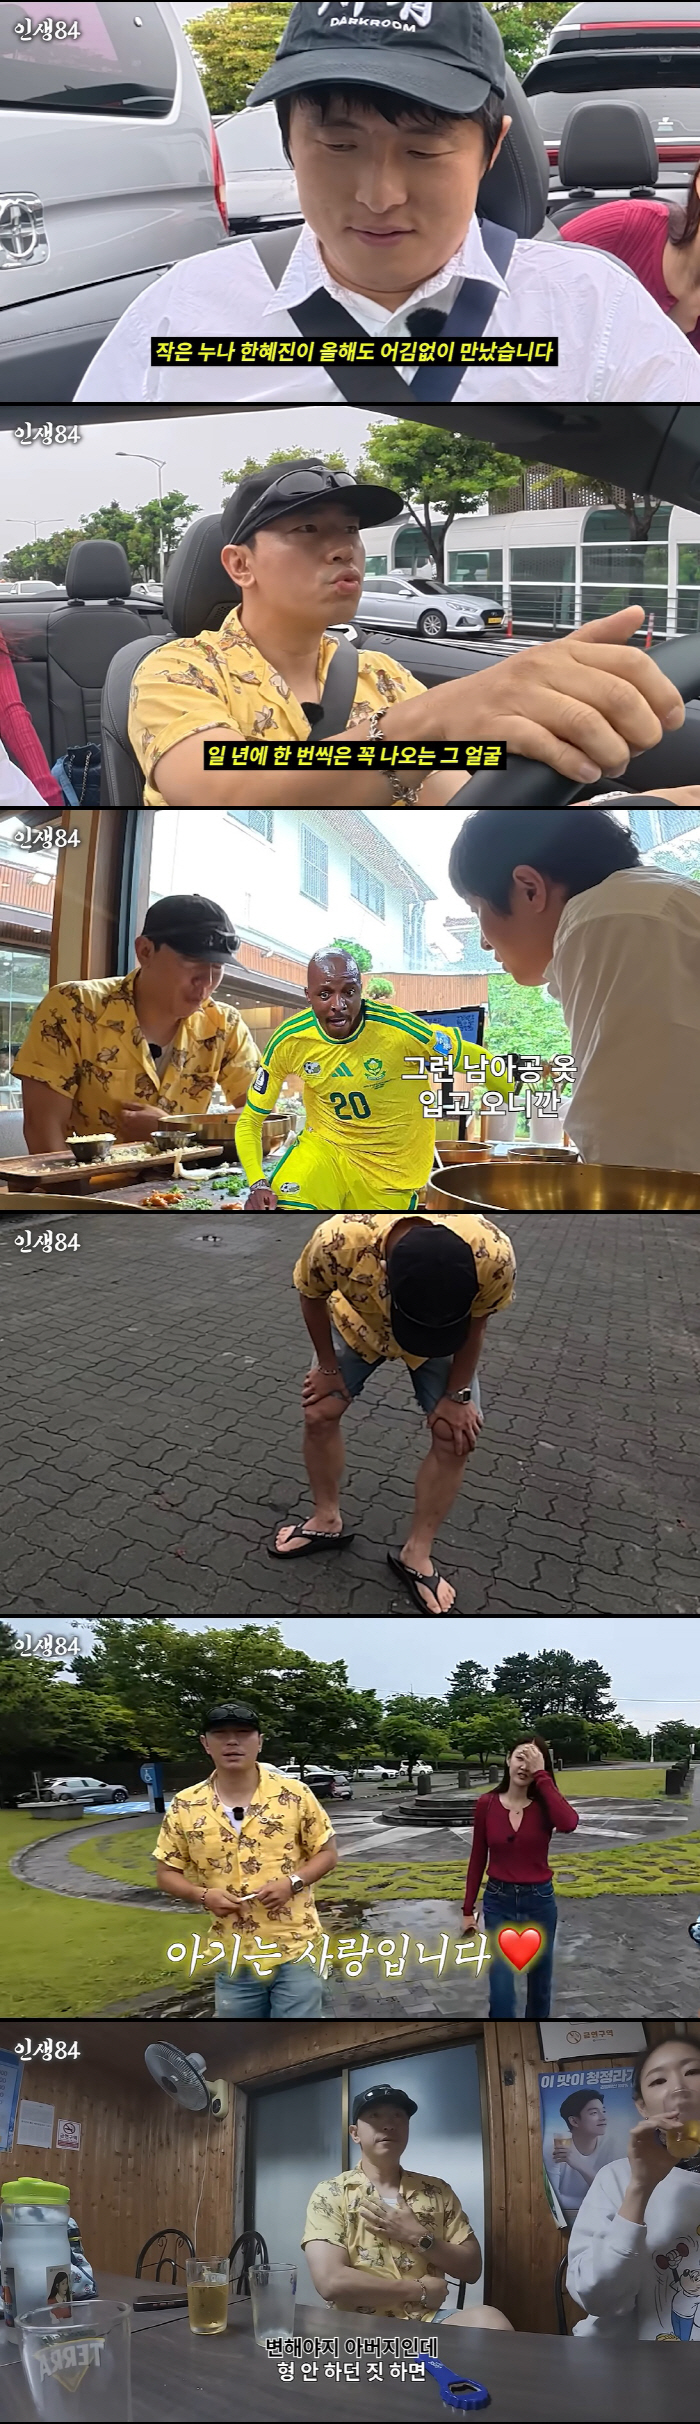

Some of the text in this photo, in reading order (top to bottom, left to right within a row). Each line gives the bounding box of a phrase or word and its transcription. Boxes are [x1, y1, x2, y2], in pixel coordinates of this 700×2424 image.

[330, 17, 416, 32] DARKROOM
[329, 1091, 372, 1120] 20
[583, 2029, 614, 2039] 금연구역
[540, 2074, 555, 2089] 이
[556, 2072, 585, 2088] 맛이
